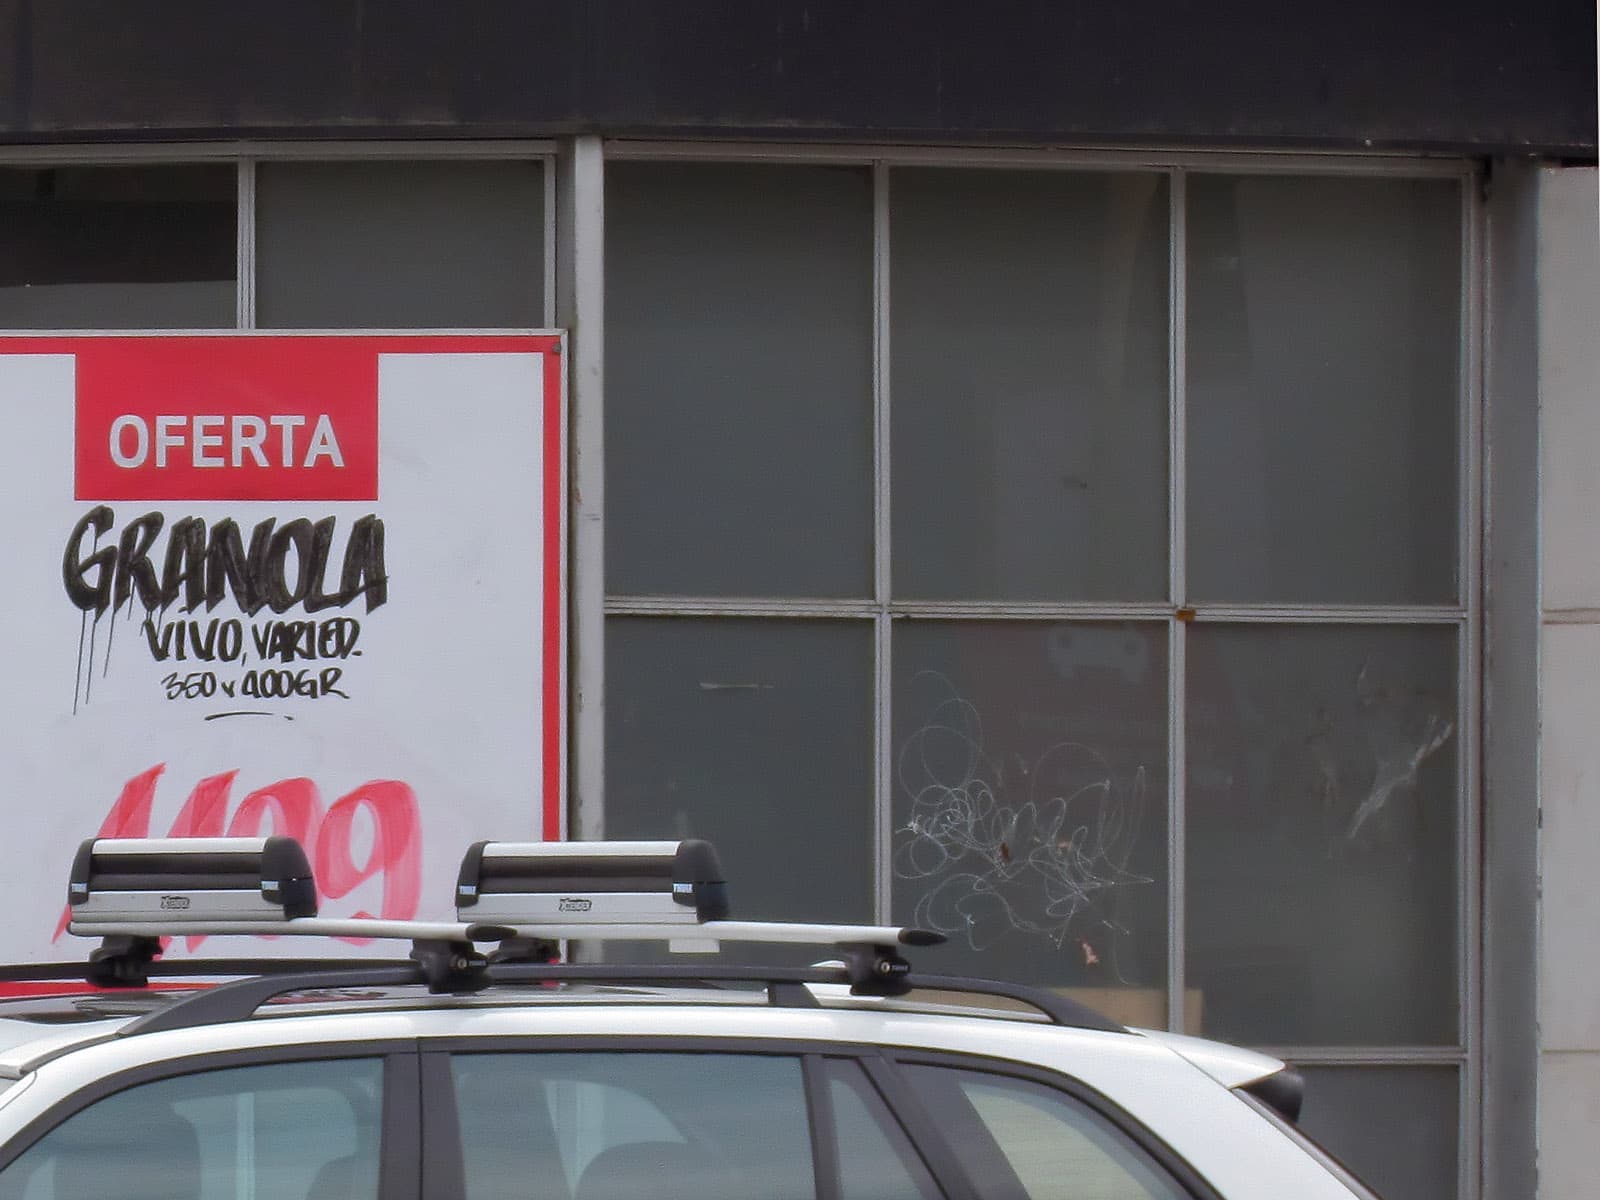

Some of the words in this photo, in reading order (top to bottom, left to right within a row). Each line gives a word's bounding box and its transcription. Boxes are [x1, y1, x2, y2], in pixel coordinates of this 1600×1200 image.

[109, 415, 345, 468] OFERTA
[63, 505, 389, 616] GRANOLA
[161, 671, 216, 700] 350
